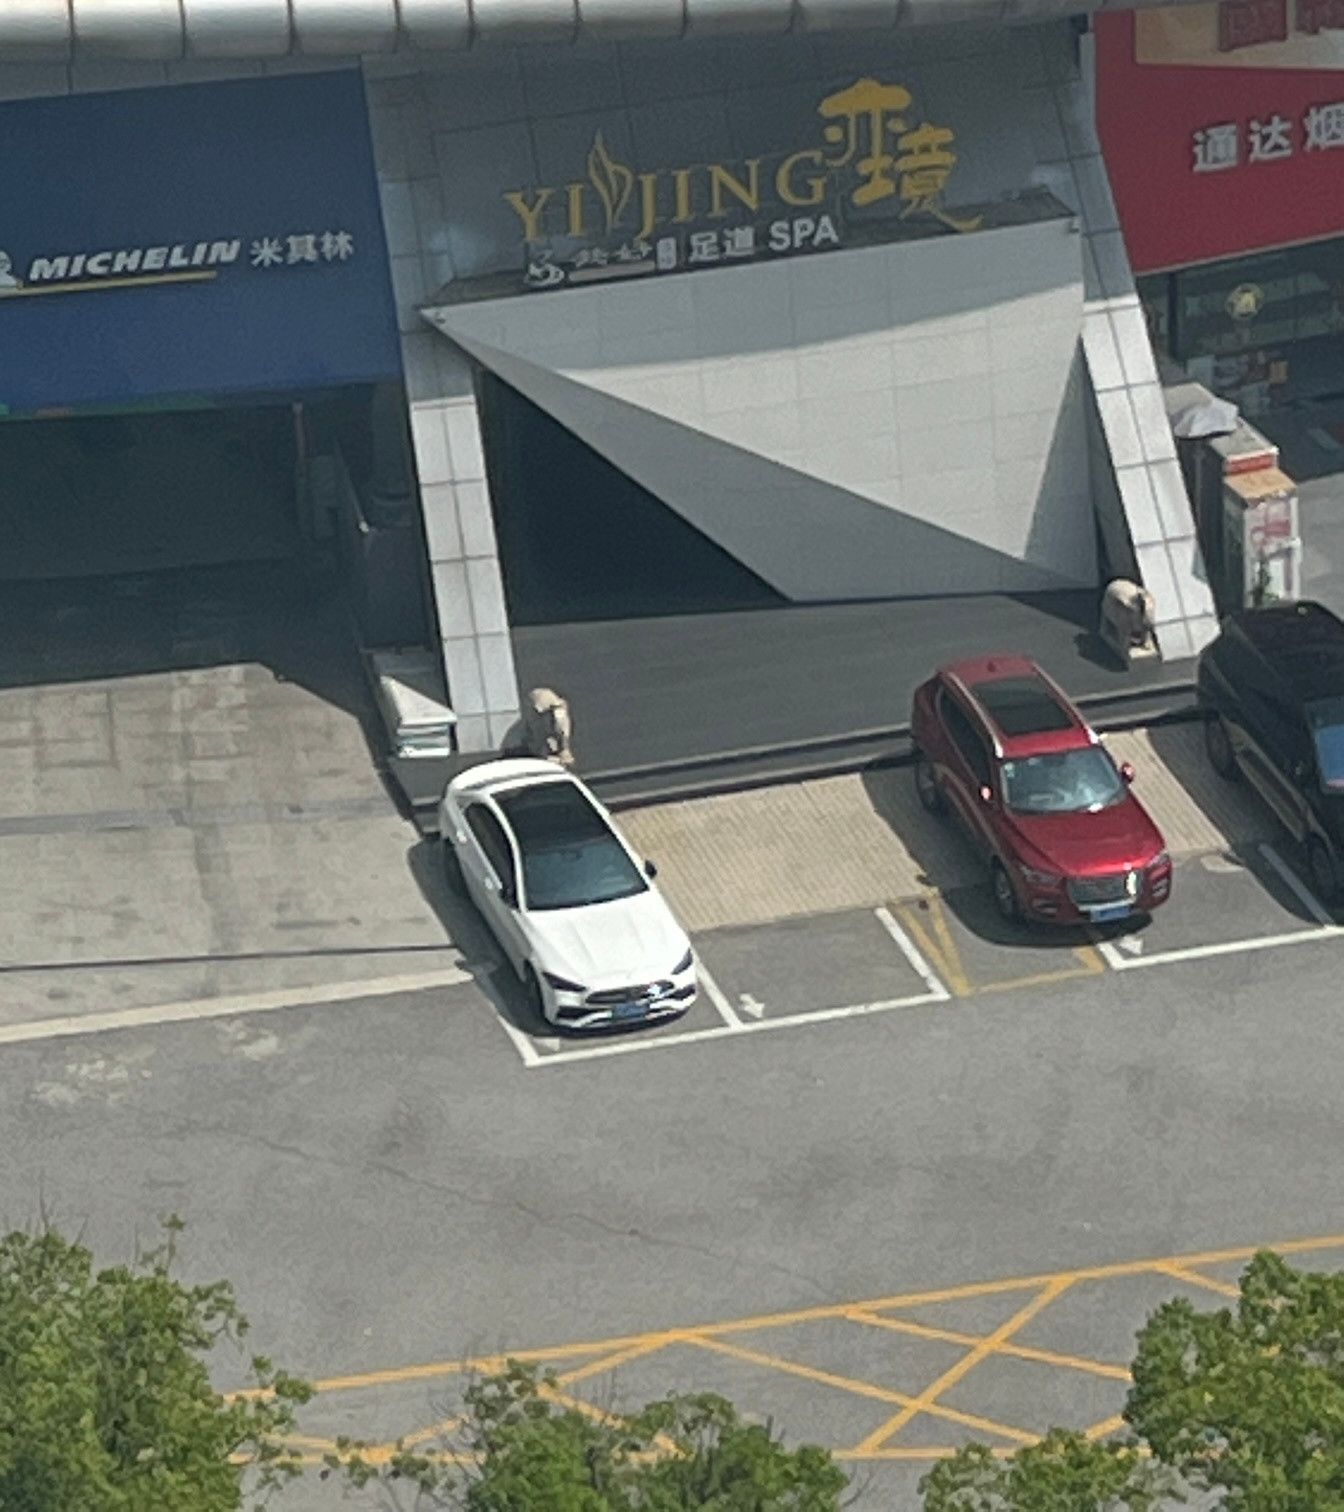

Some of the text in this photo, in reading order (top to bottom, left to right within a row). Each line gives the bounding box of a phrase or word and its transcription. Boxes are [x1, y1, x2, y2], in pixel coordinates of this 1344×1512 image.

[768, 214, 839, 252] SPA
[29, 230, 355, 281] MICHELIN 米其林
